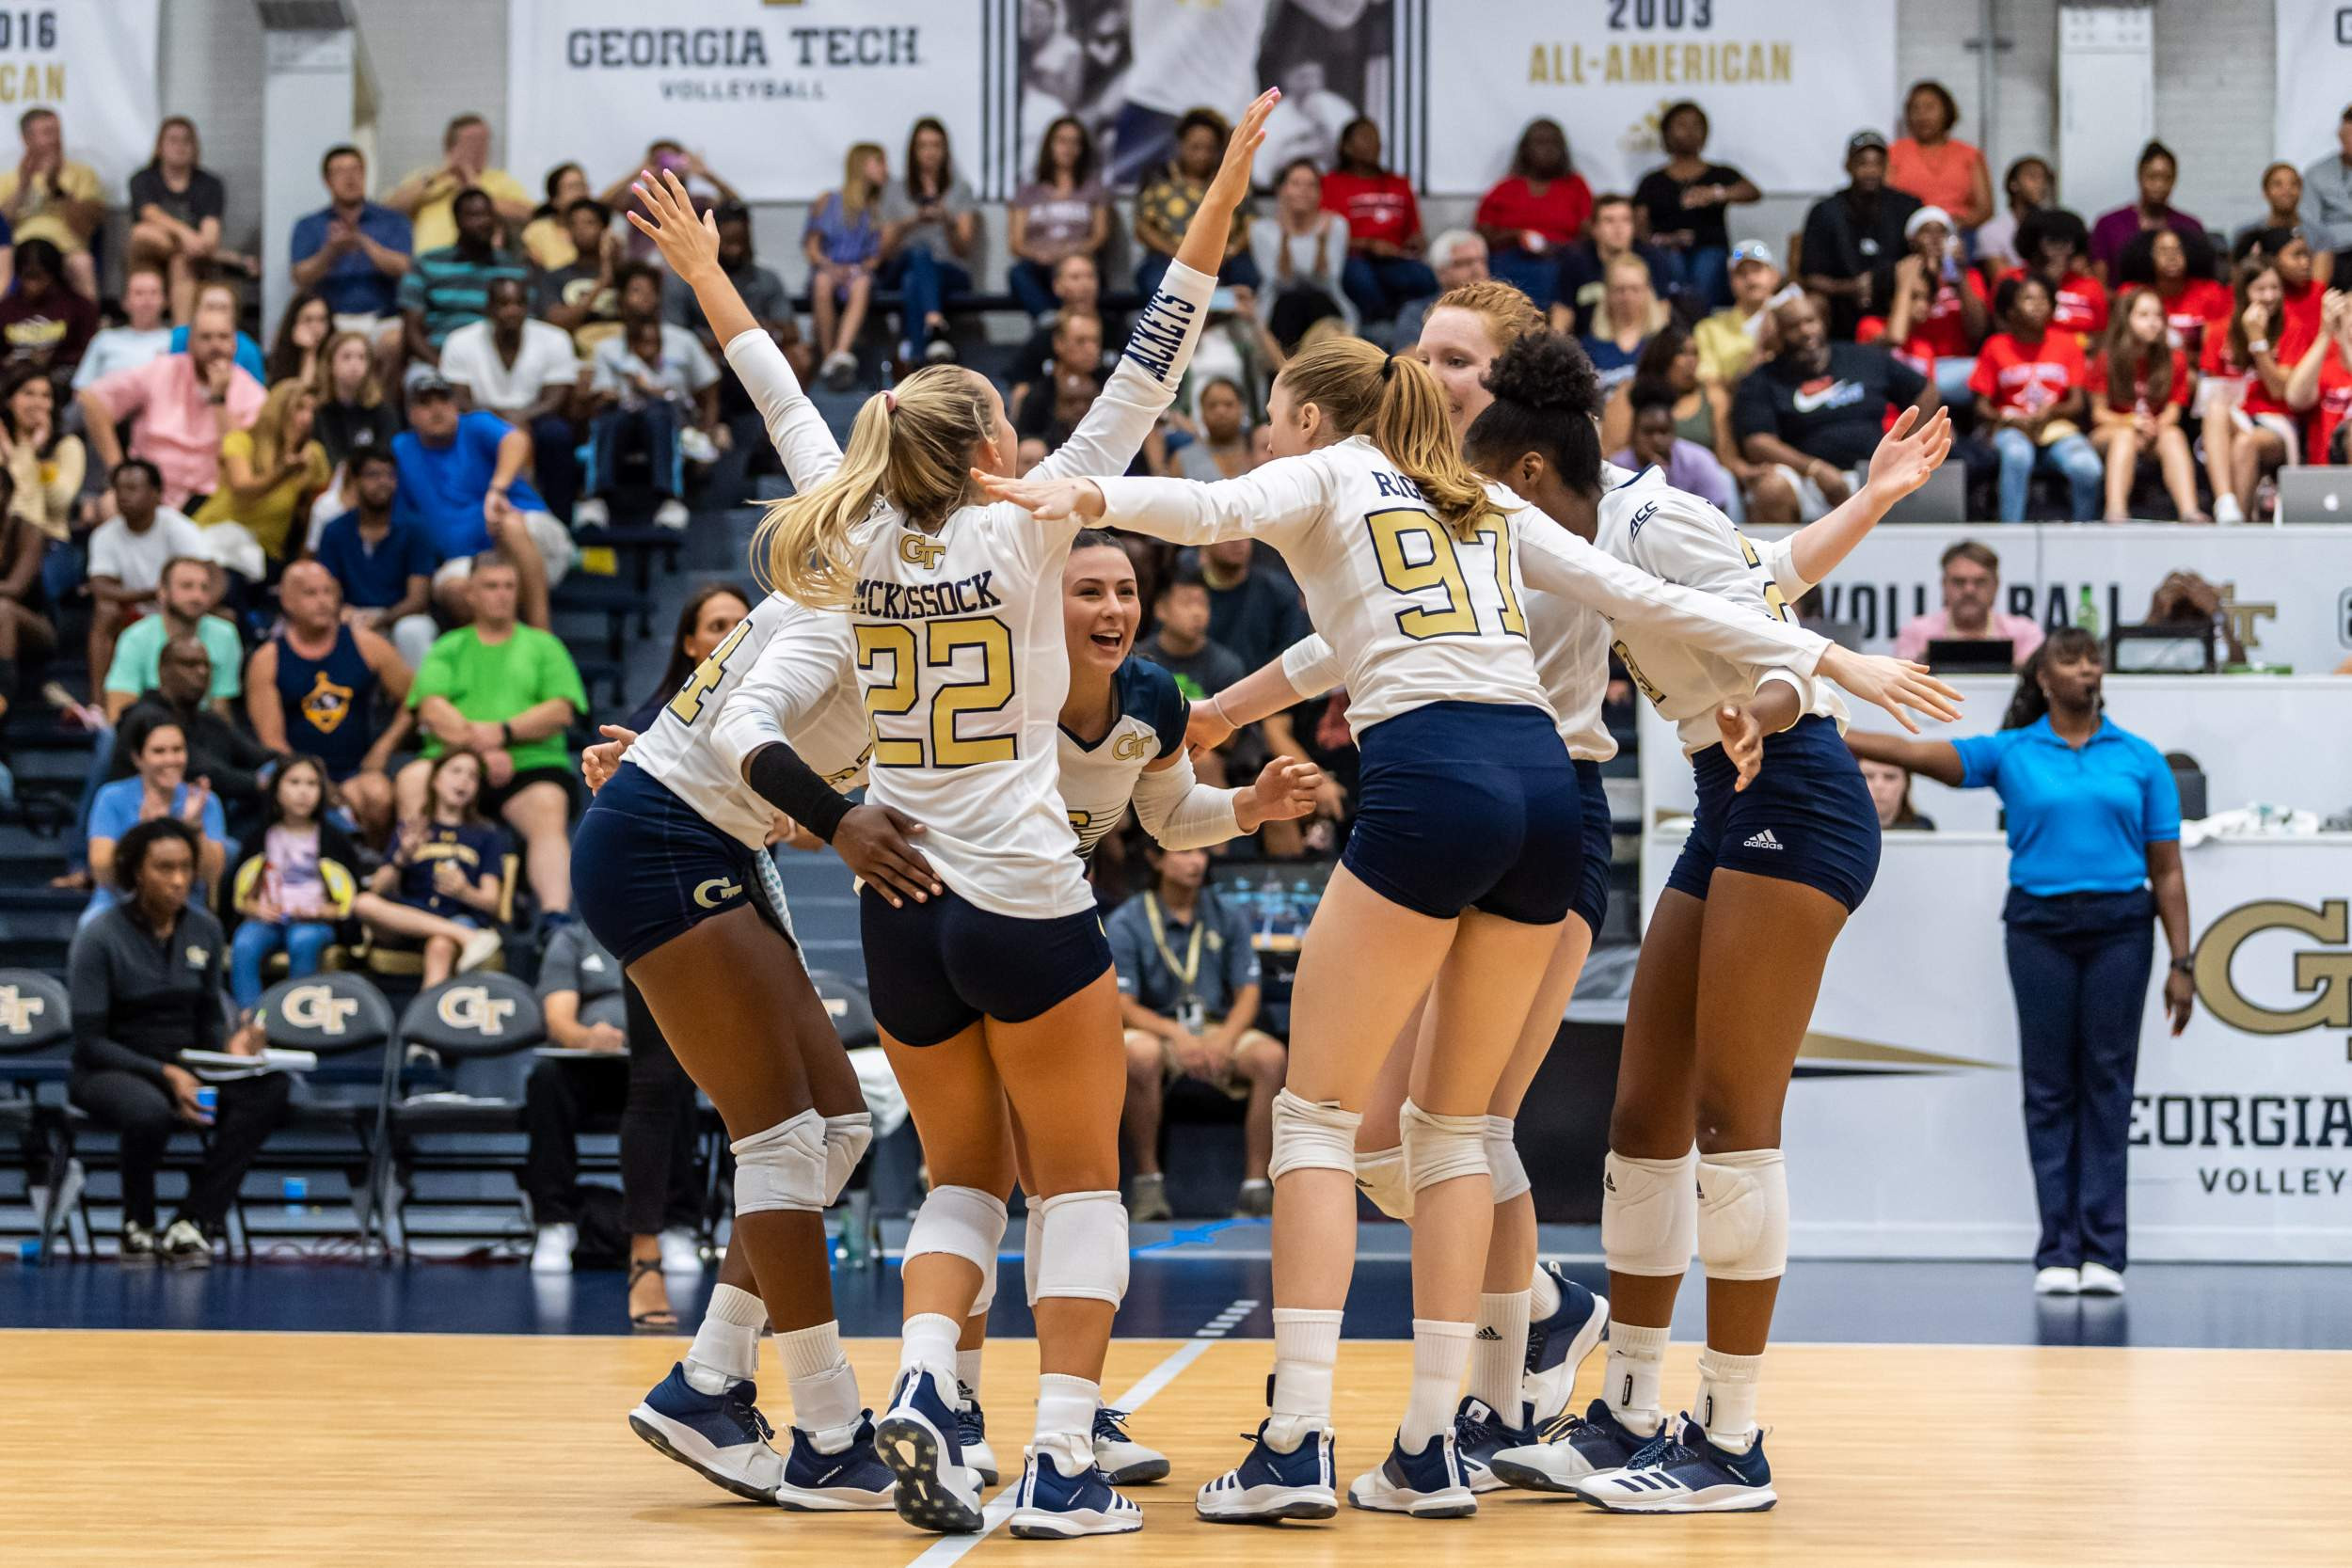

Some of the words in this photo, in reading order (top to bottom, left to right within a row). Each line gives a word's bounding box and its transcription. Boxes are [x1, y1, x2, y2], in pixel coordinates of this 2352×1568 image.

[1608, 0, 1712, 30] 2003
[568, 28, 768, 68] GEORGIA
[790, 26, 921, 66] TECH
[1529, 43, 1792, 85] ALL-AMERICAN
[660, 79, 824, 100] VOLLEYBALL
[1123, 288, 1196, 383] ACKETS
[1371, 470, 1424, 501] RIG
[1629, 500, 1659, 542] ACC
[899, 534, 946, 570] GT
[852, 615, 1019, 769] 22
[1112, 730, 1153, 761] GT
[1743, 839, 1784, 850] adidas
[281, 985, 358, 1035] GT
[437, 986, 516, 1035] GT
[2128, 1095, 2352, 1148] EORGIA
[2198, 1168, 2346, 1195] VOLLEY
